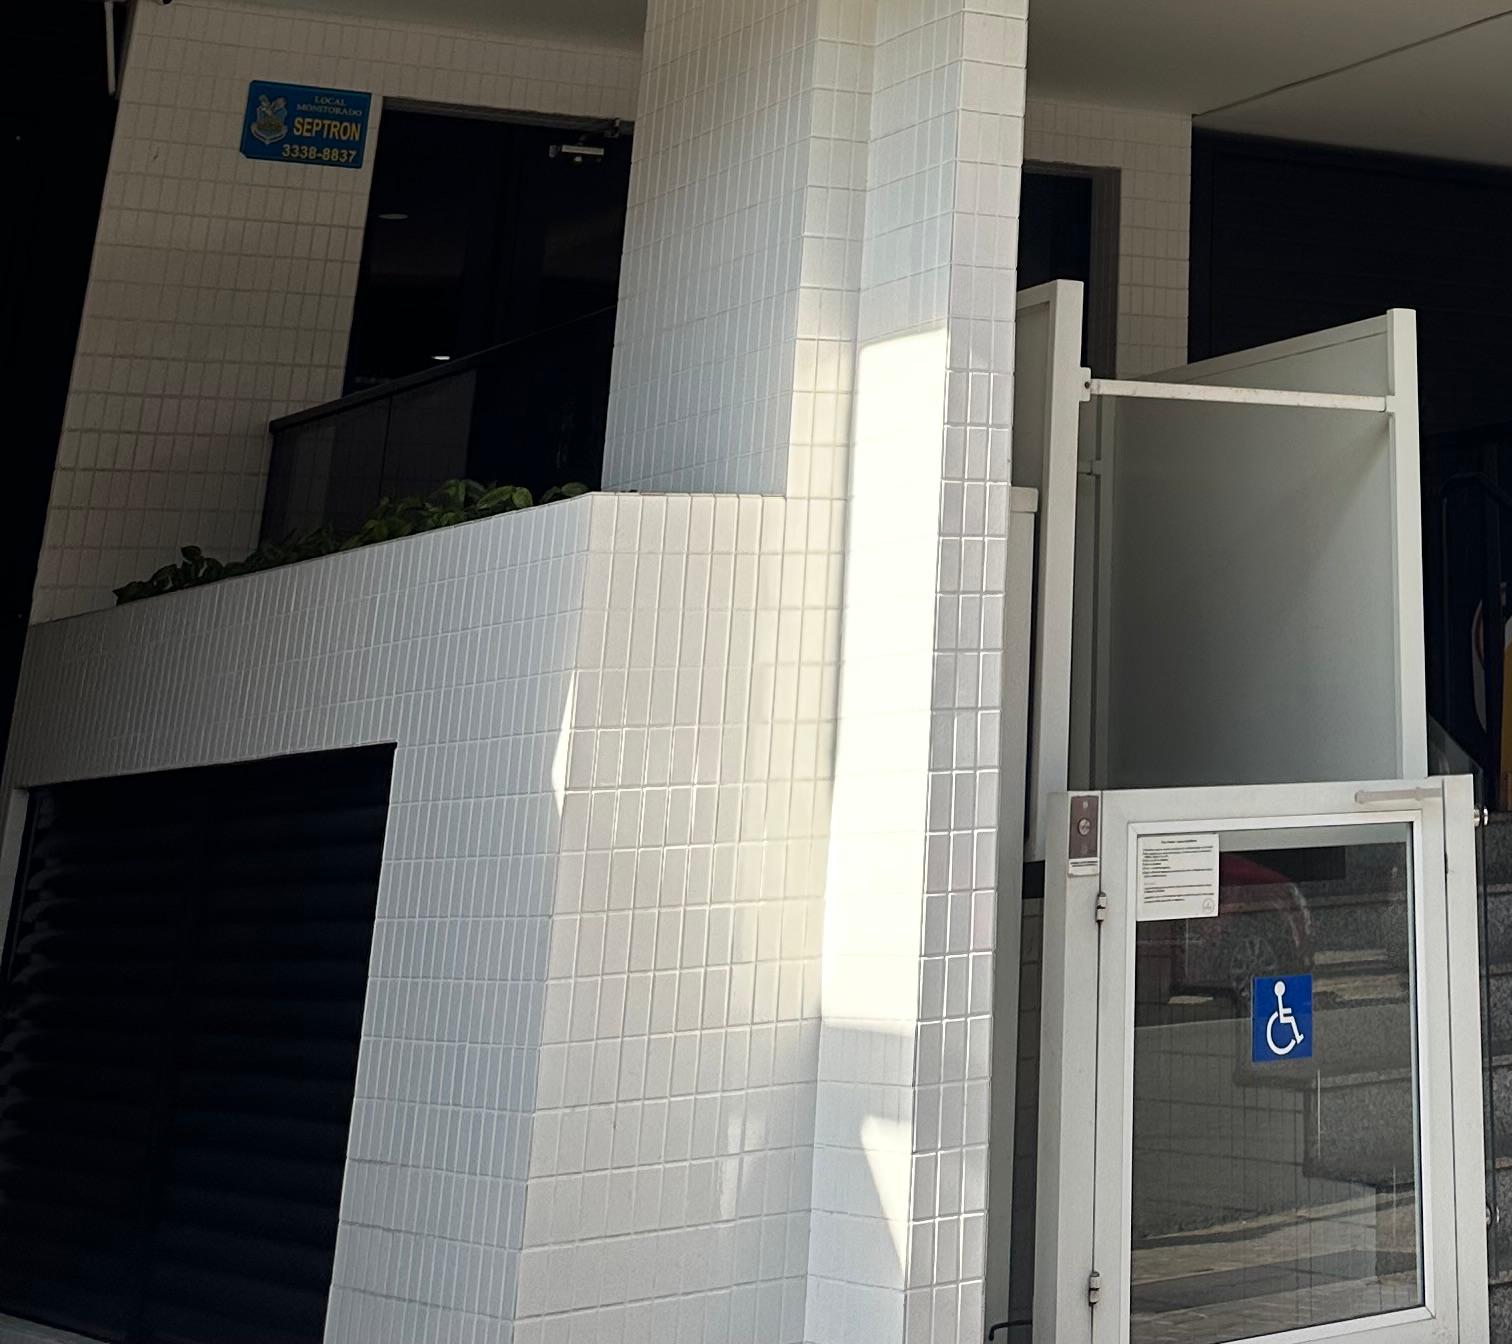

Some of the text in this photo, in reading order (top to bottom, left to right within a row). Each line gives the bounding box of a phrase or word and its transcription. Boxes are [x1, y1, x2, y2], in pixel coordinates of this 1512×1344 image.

[314, 96, 346, 106] LOCAL
[296, 104, 363, 116] MONITORADO
[293, 116, 361, 141] SEPTRON
[281, 144, 357, 163] 3338-8837
